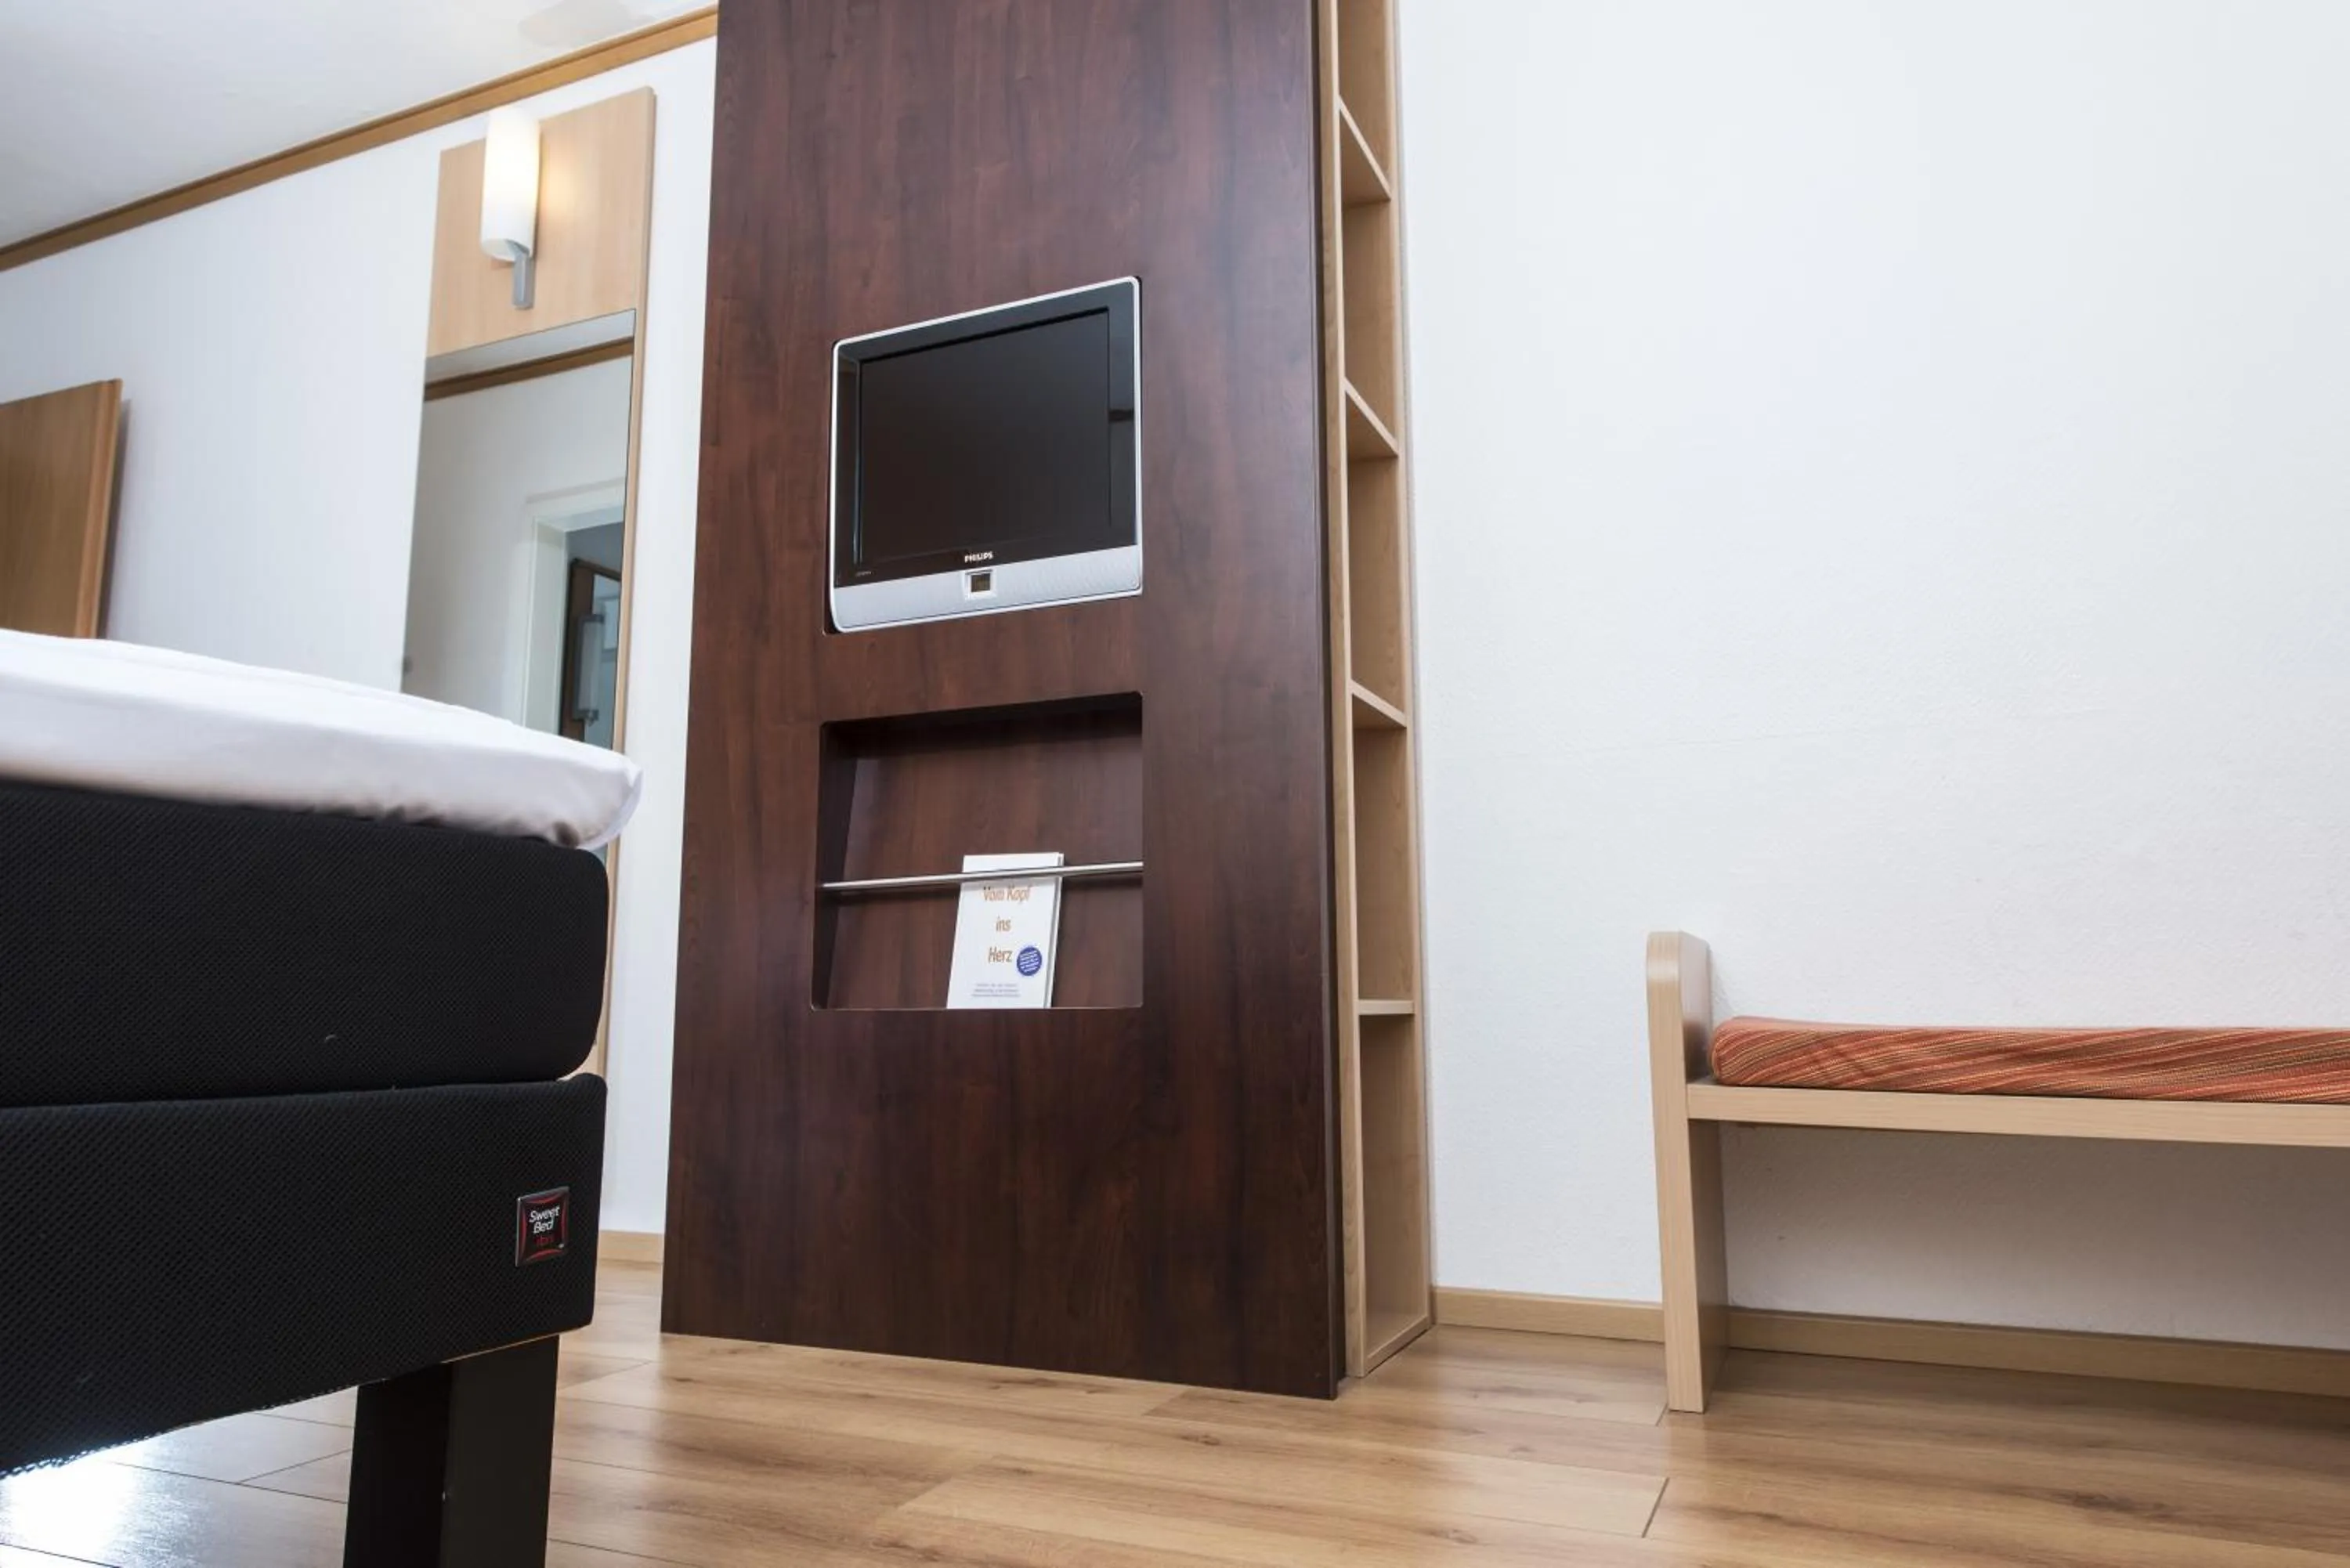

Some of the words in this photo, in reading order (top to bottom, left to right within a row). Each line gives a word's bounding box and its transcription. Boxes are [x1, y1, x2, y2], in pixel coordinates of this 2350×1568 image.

[964, 551, 992, 563] PHILIPS
[1007, 883, 1032, 903] Kopf
[996, 916, 1011, 932] ins
[988, 946, 1013, 963] Herz
[529, 1205, 560, 1223] Sweet
[533, 1218, 554, 1234] Bed
